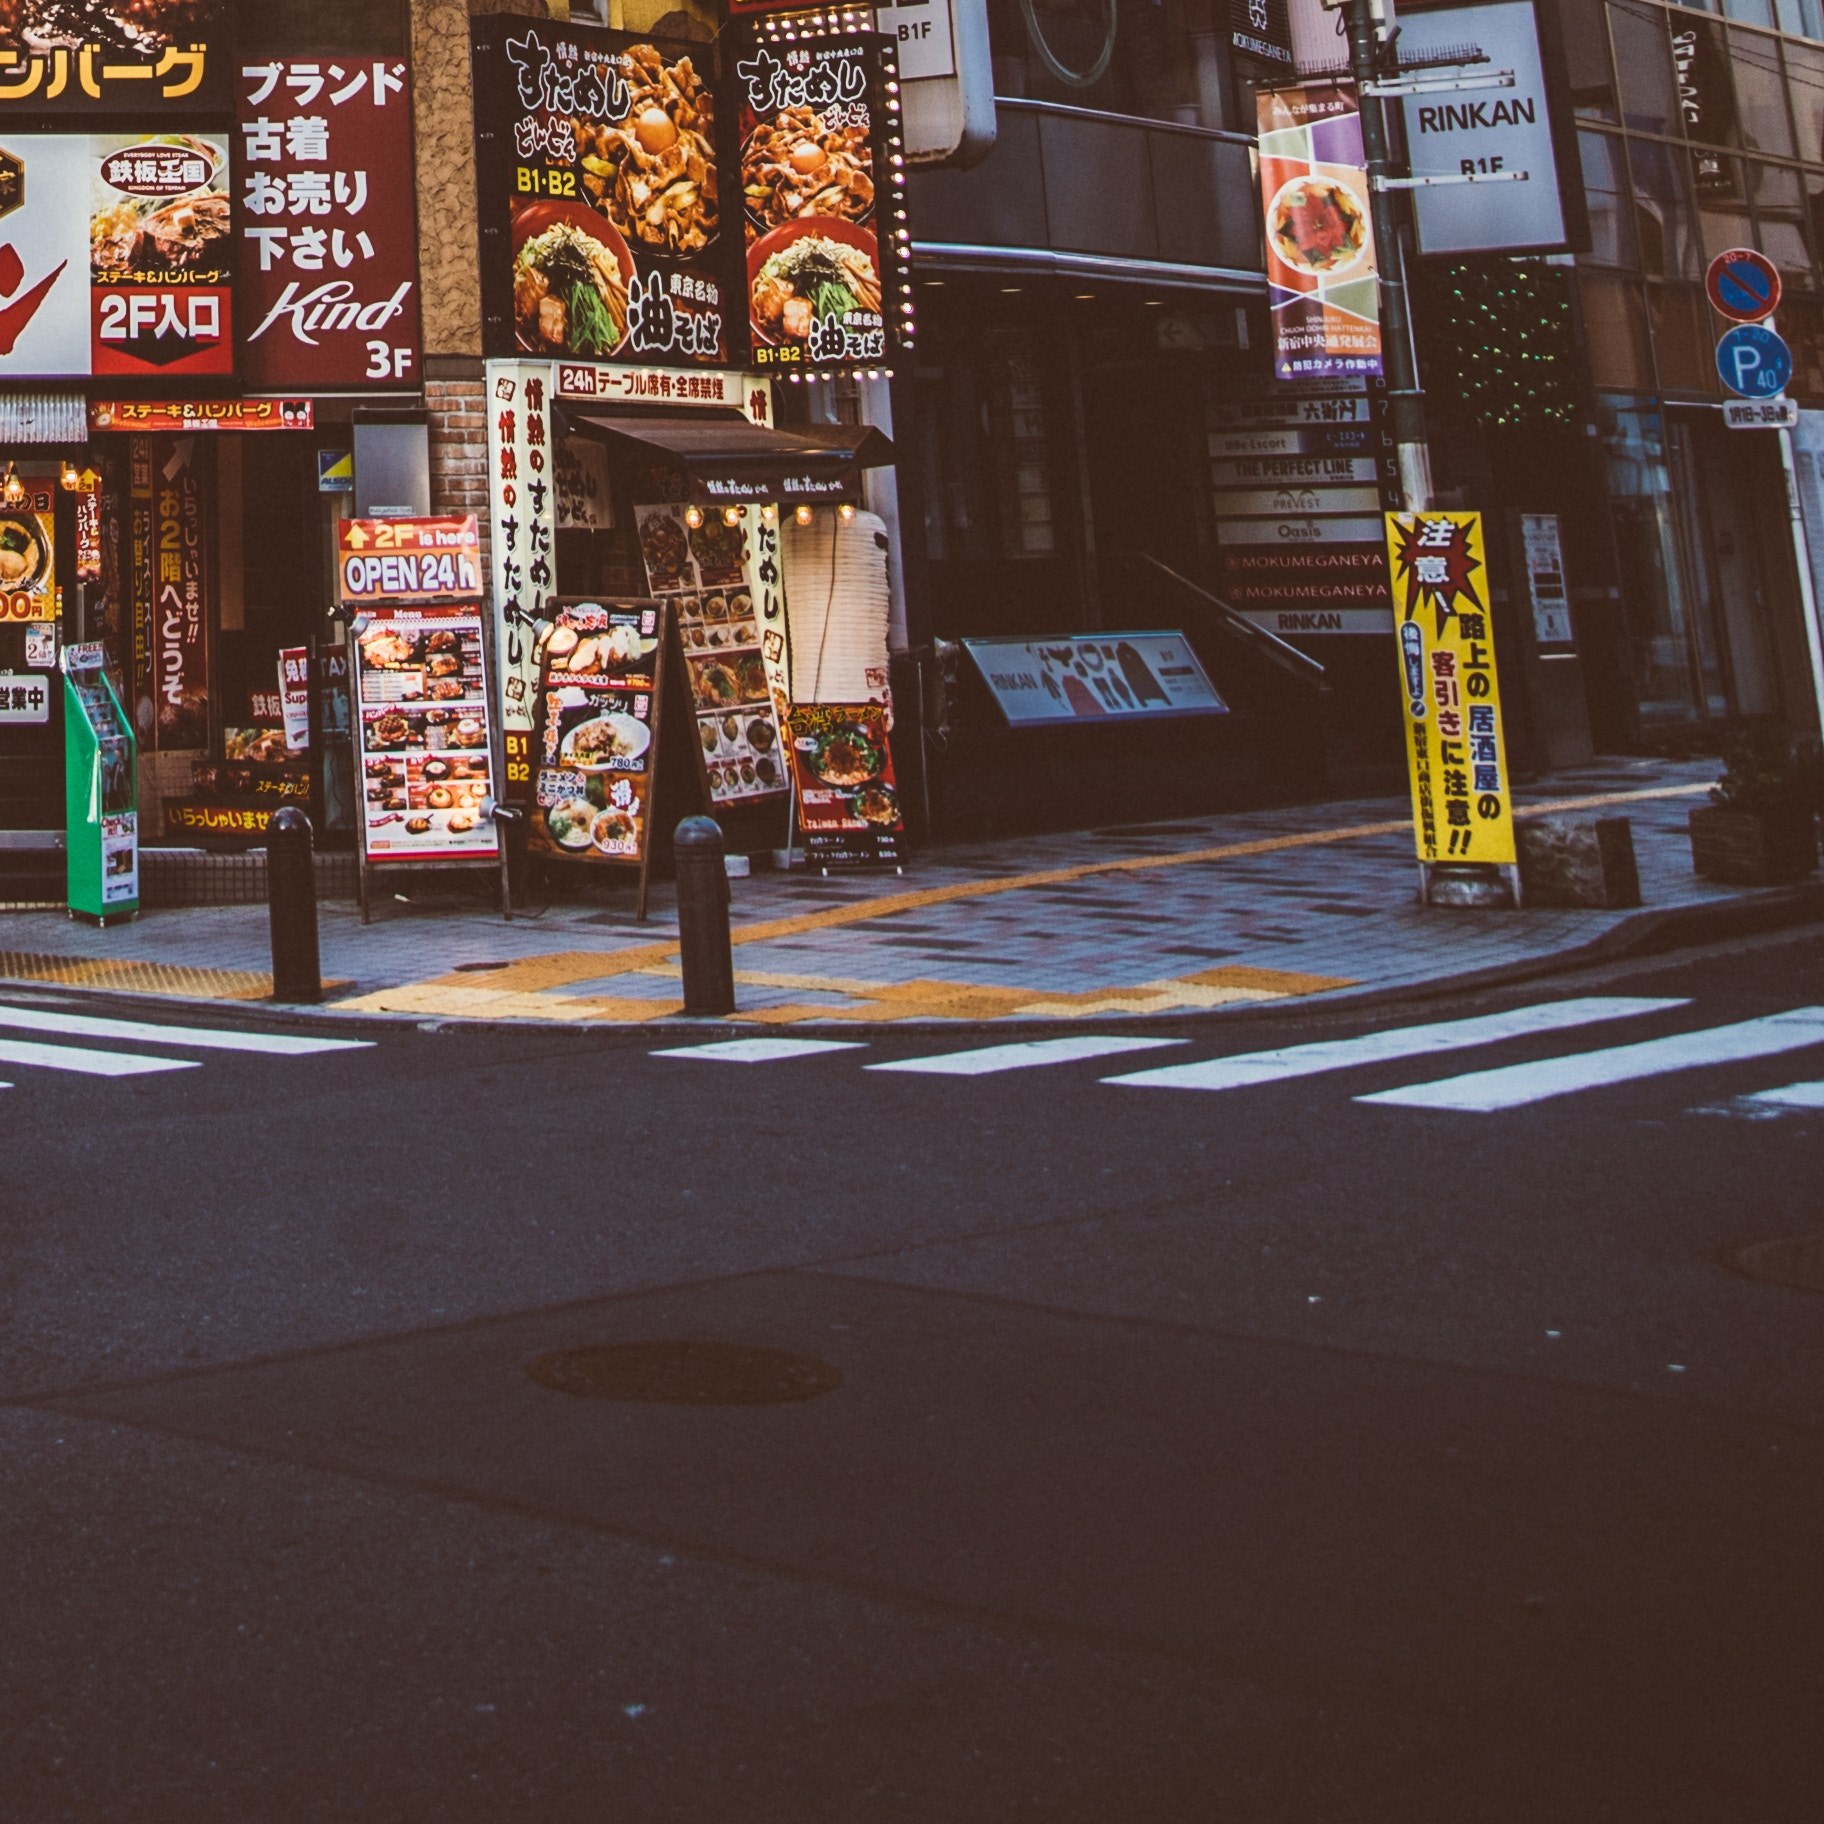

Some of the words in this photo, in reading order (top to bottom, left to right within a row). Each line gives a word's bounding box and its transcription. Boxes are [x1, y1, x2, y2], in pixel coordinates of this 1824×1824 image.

[895, 20, 932, 43] B1F
[241, 62, 406, 108] ブランド
[1418, 98, 1536, 134] RINKAN
[241, 115, 329, 161] 古着
[107, 158, 206, 184] 鉄板王国
[243, 171, 368, 216] お売り
[241, 226, 374, 270] 下さい
[97, 269, 219, 284] ステーキ&ハンバーグ
[669, 273, 720, 305] 東京名物
[99, 293, 220, 341] 2F入口
[246, 280, 413, 346] Kind
[626, 269, 721, 354] 油そば
[808, 312, 886, 361] 油そば
[364, 339, 413, 380] 3F
[1291, 357, 1379, 372] 防犯カメラ作動中
[1732, 345, 1761, 390] P
[562, 367, 595, 393] 24h
[1756, 369, 1776, 389] 40
[122, 401, 273, 419] ステーキ&ハンバーグ
[321, 476, 352, 485] ALSOK
[1236, 462, 1259, 477] THE
[1263, 460, 1321, 476] PERFECT
[1325, 459, 1354, 474] LINE
[375, 524, 414, 549] 2F
[419, 530, 433, 546] is
[436, 529, 476, 546] here
[1278, 524, 1322, 537] Oasis
[1242, 554, 1383, 567] MOKUMEGANEYA
[346, 555, 419, 593] OPEN
[1245, 583, 1387, 598] MOKUMEGANEYA
[1278, 612, 1342, 630] RINKAN
[989, 672, 1039, 691] RINKAN
